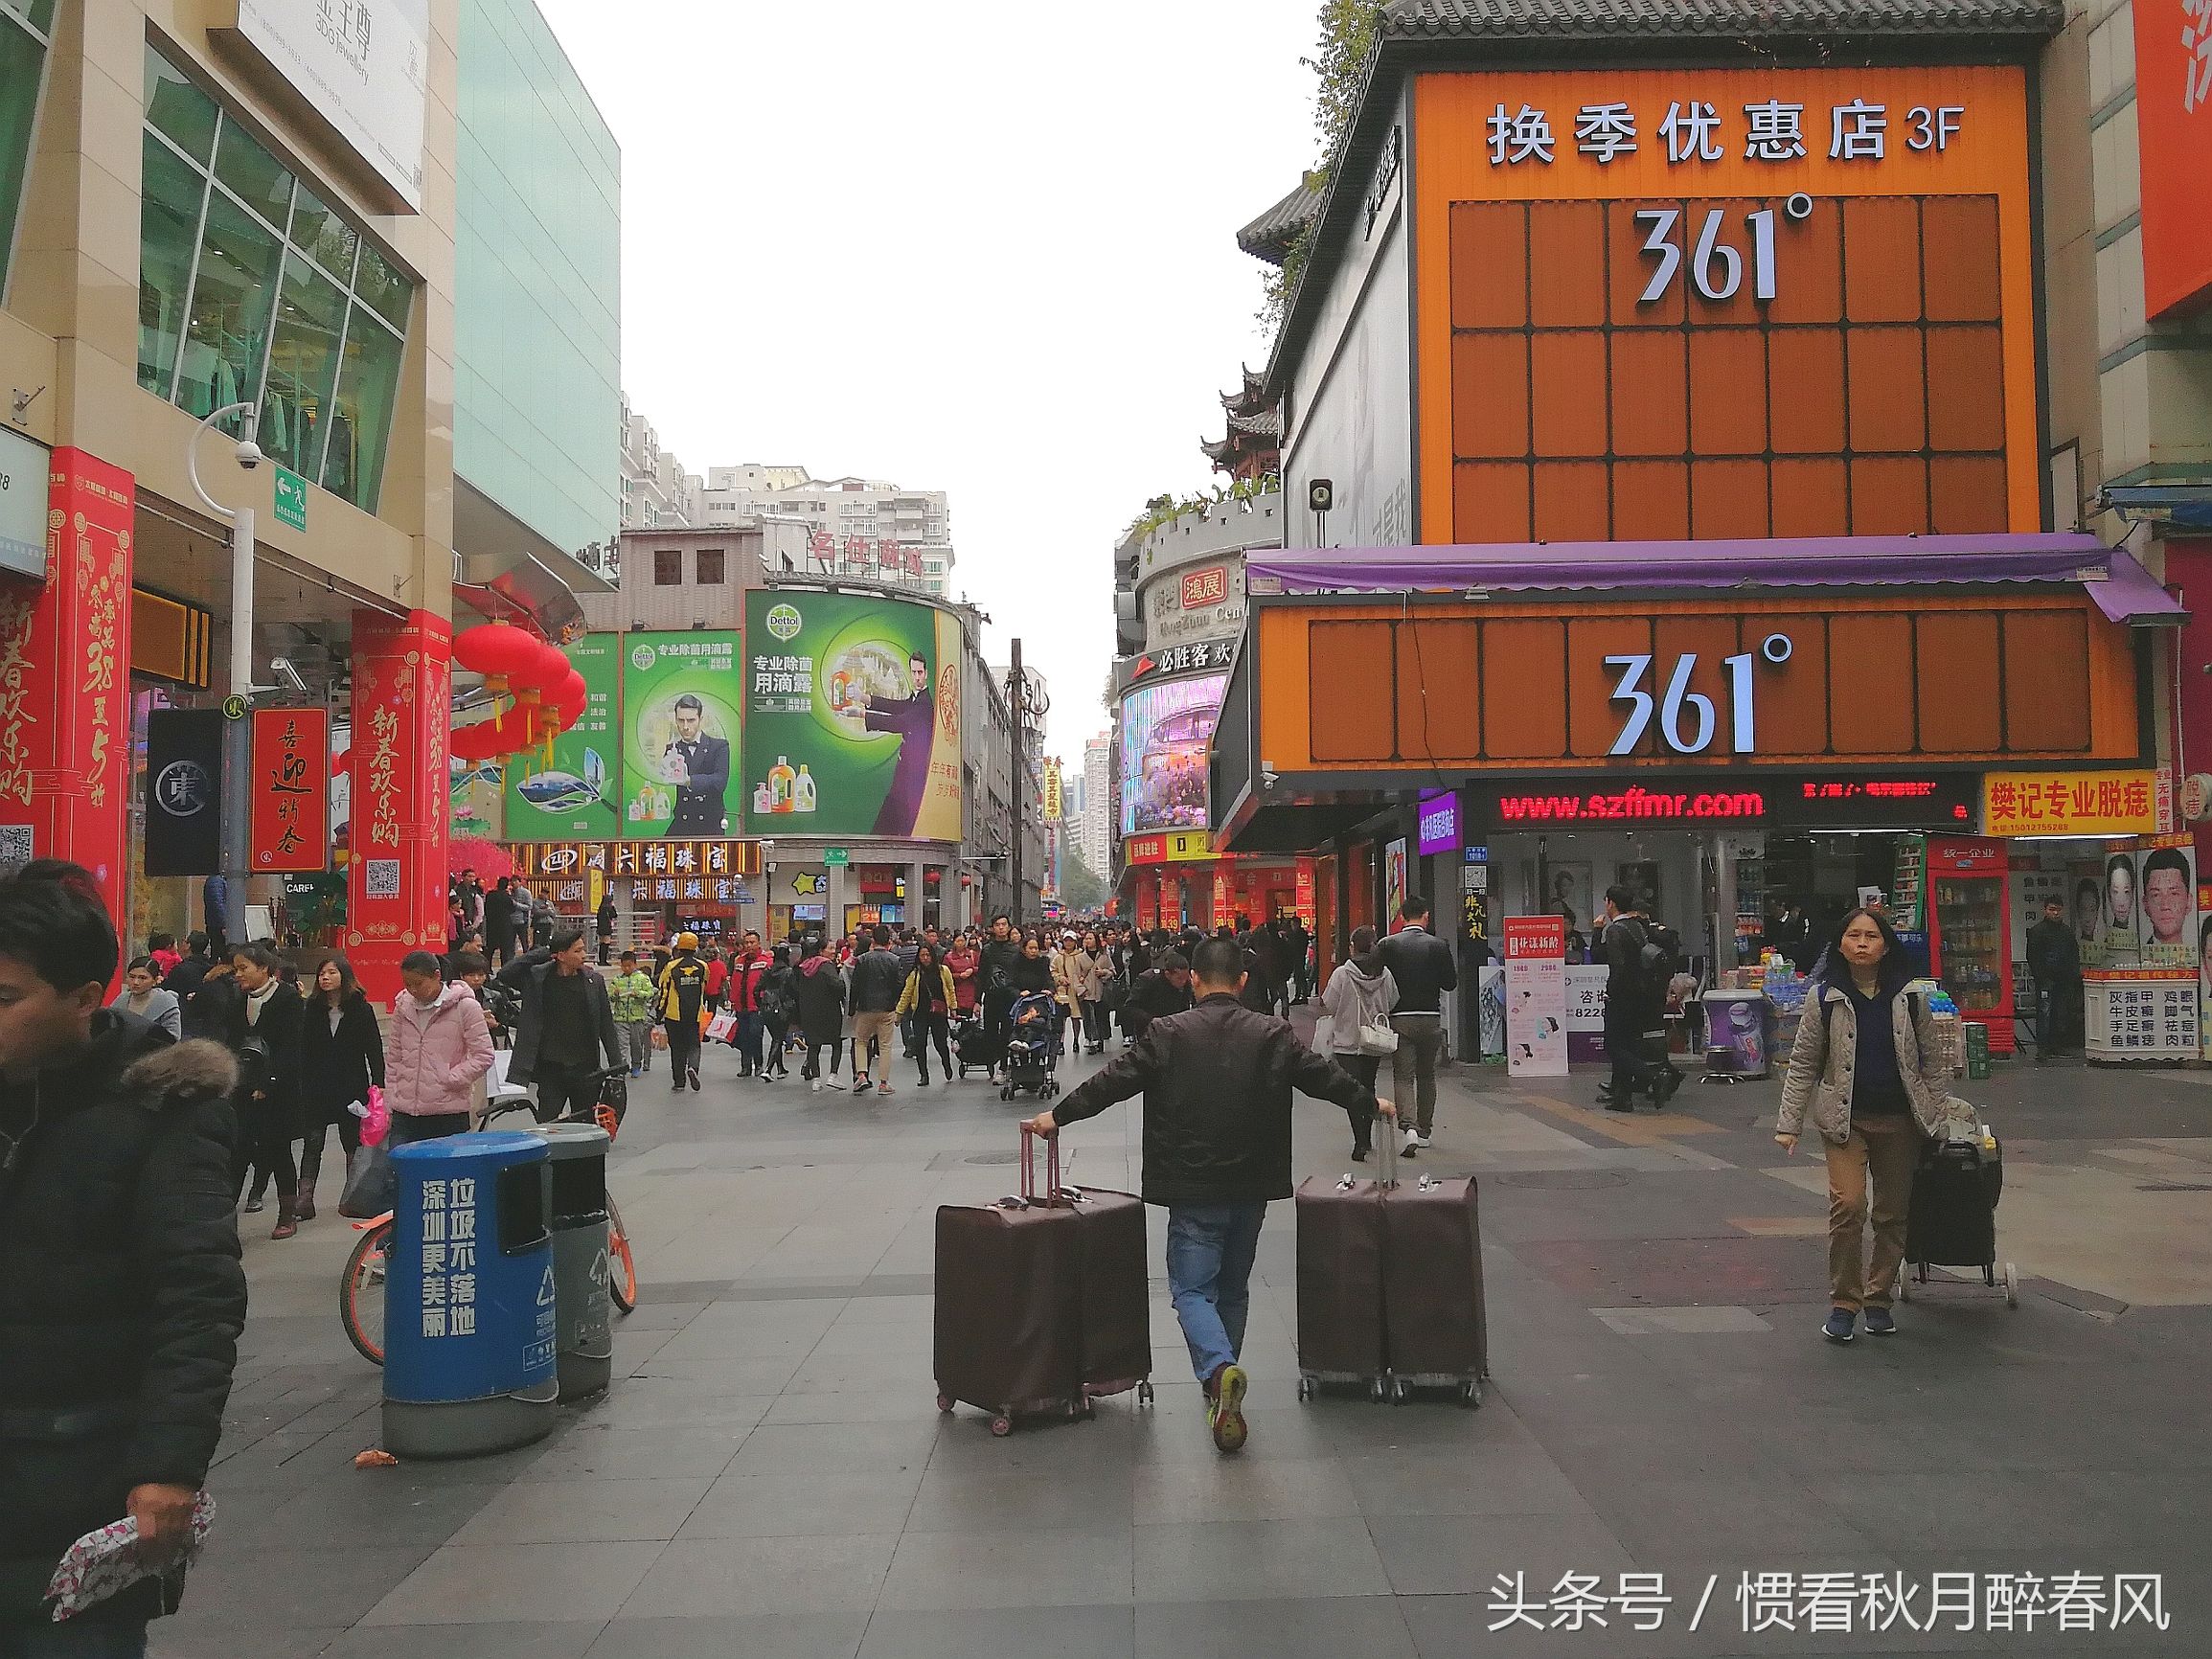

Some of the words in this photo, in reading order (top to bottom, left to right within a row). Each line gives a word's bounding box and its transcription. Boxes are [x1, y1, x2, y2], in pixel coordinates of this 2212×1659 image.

[316, 13, 335, 45] 3DG
[335, 32, 369, 86] Jewellery
[1486, 100, 1887, 165] 换季优惠店
[1906, 105, 1965, 152] 3F
[769, 615, 798, 626] Dettol
[658, 643, 733, 656] 专业除菌用滴露
[1159, 643, 1209, 672] 必胜客
[754, 655, 813, 672] 专业除菌
[755, 673, 813, 693] 用滴露
[368, 704, 400, 847] 新春欢乐购
[270, 719, 312, 854] 喜迎新春
[1991, 780, 2150, 821] 樊记专业脱痣
[1943, 848, 1995, 858] 统一企业
[2109, 990, 2154, 1002] 灰指甲
[2164, 990, 2194, 1002] 鸡眼
[2109, 1006, 2155, 1017] 牛皮癣
[2164, 1006, 2194, 1017] 脚气
[2165, 1020, 2194, 1032] 祛痘
[2165, 1034, 2195, 1046] 肉粒
[422, 1179, 446, 1338] 深圳更美丽
[449, 1177, 476, 1336] 垃圾不落地
